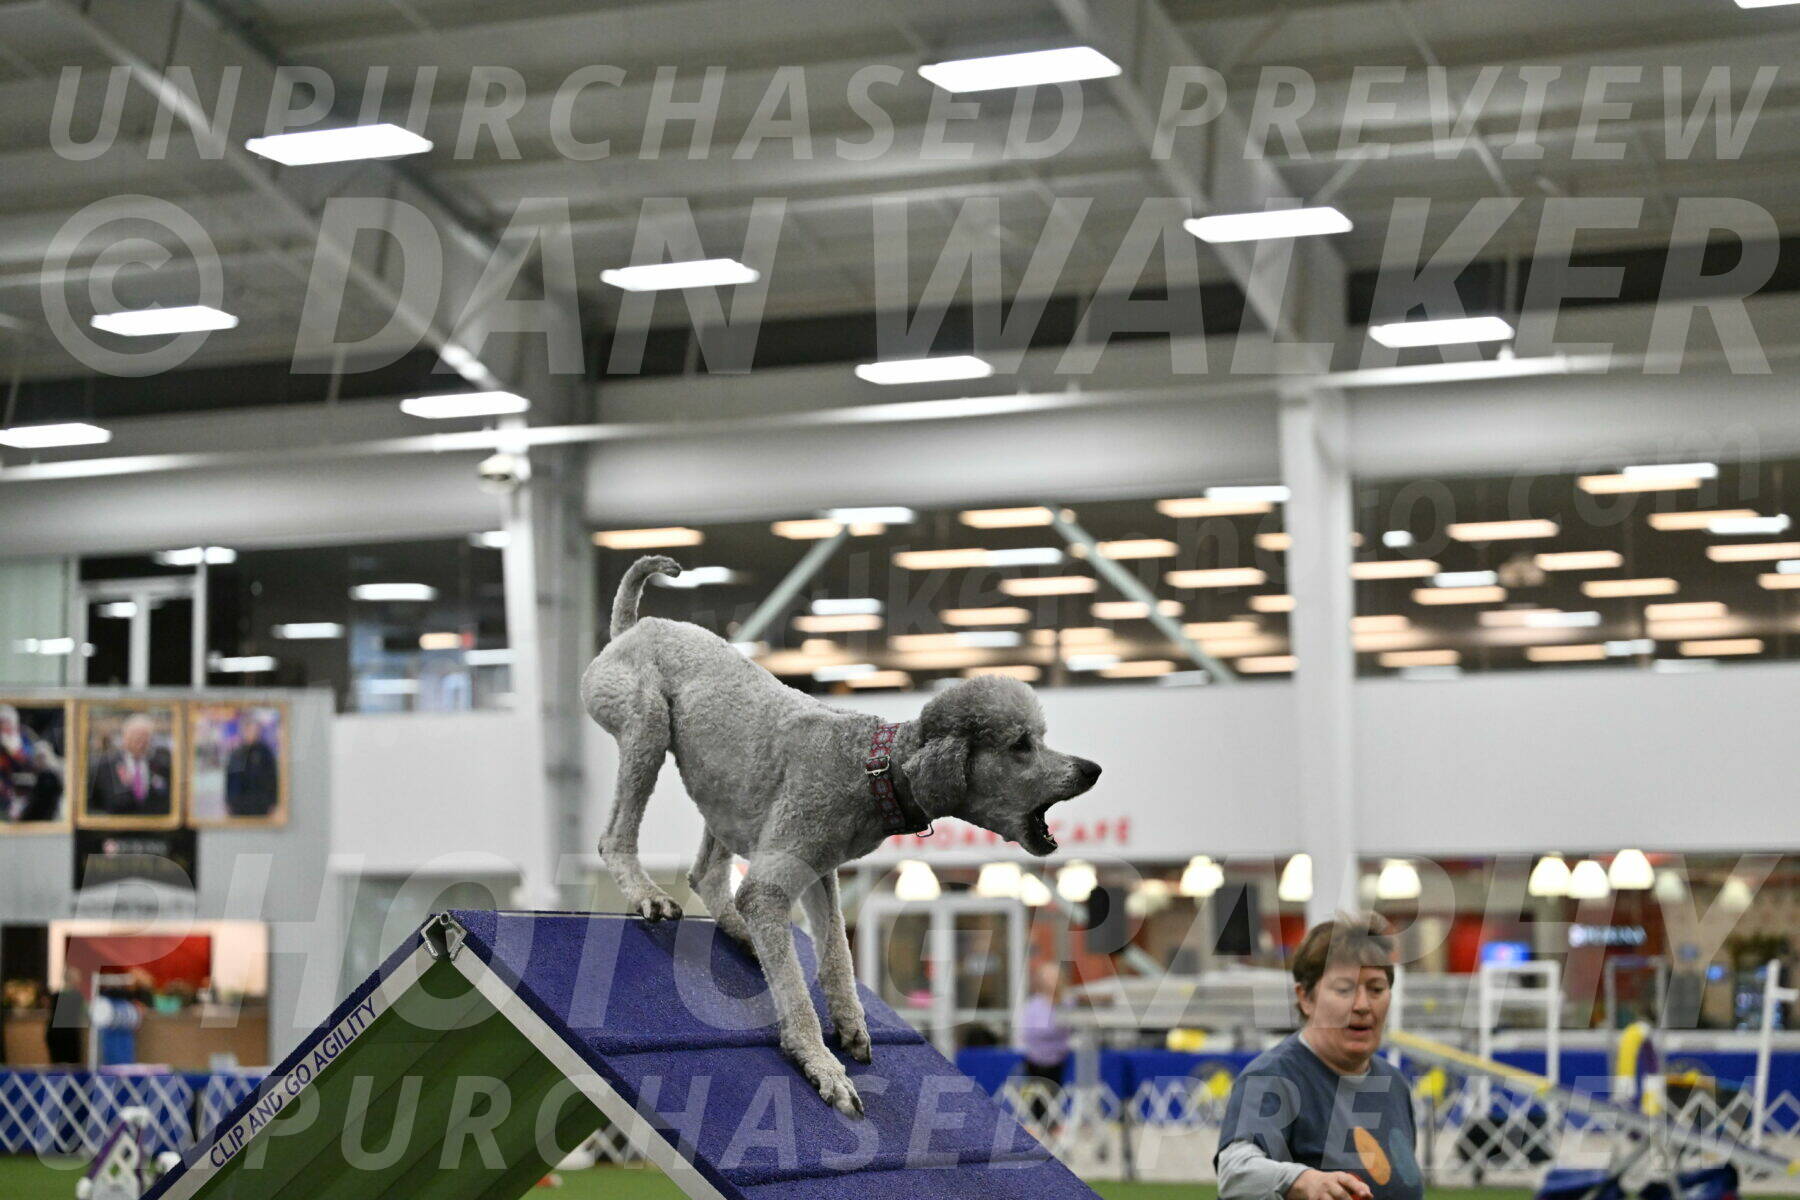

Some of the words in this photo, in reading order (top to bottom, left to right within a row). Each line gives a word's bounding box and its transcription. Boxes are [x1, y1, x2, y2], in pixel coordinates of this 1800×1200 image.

[210, 1125, 245, 1168] CLIP
[248, 1090, 283, 1135] AND
[284, 1063, 312, 1096] GO
[312, 996, 377, 1073] AGILITY
